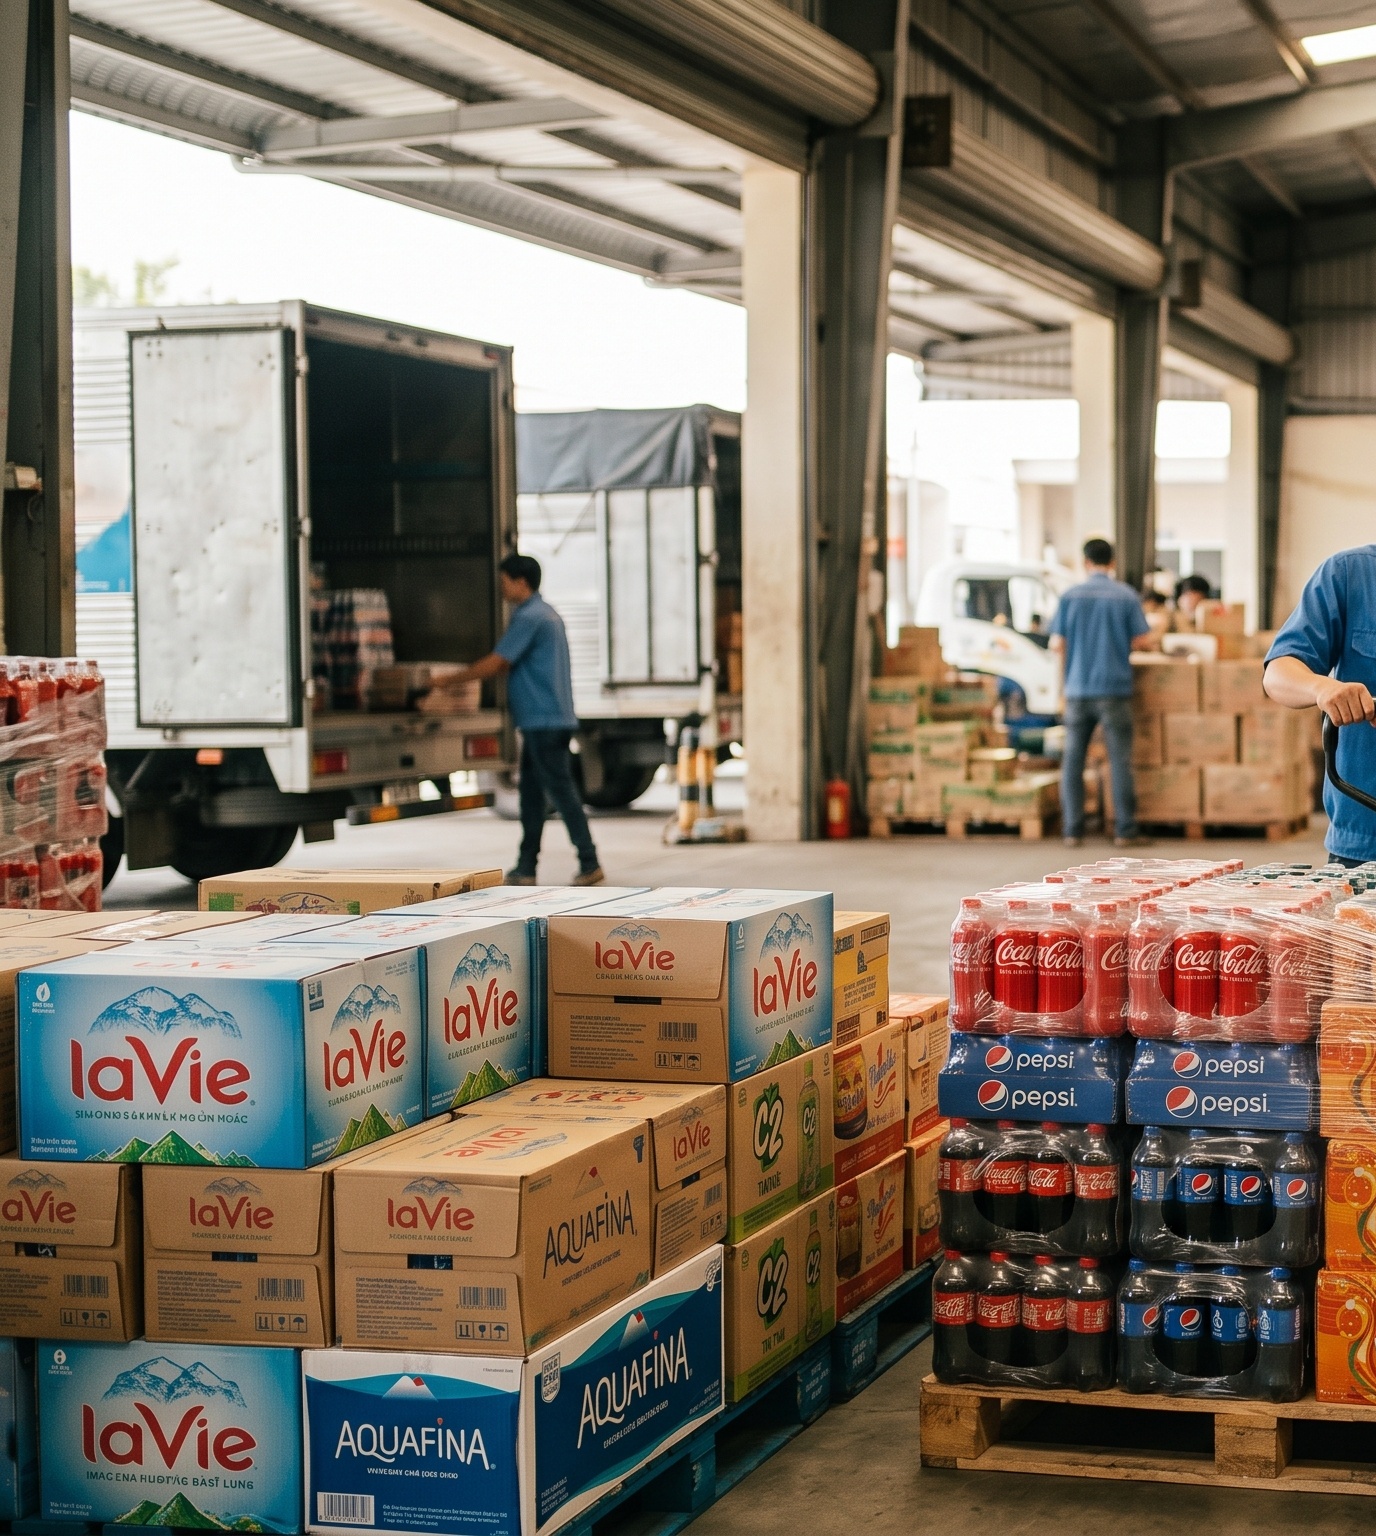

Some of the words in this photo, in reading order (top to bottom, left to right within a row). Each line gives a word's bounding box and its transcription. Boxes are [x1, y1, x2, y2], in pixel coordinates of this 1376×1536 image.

[595, 940, 675, 972] laVie
[752, 948, 817, 1019] laVie
[443, 977, 519, 1045] laVie
[70, 1035, 251, 1105] laVie
[323, 1018, 407, 1091] laVie
[1016, 1051, 1074, 1072] pepsi
[1204, 1056, 1265, 1077] pepsi
[1011, 1080, 1076, 1107] pepsi
[1201, 1093, 1268, 1116] pepsi
[673, 1120, 711, 1162] laVie
[753, 1100, 784, 1161] C2
[802, 1106, 817, 1134] C2
[0, 1190, 77, 1225] aVie
[189, 1195, 274, 1230] laVie
[387, 1196, 475, 1232] laVie
[543, 1190, 636, 1279] AQUAFINA
[757, 1253, 788, 1315] C2
[806, 1250, 820, 1284] C2
[577, 1326, 690, 1449] AQUAFINA
[81, 1402, 257, 1473] laVie
[335, 1416, 491, 1471] AQUAFINA
